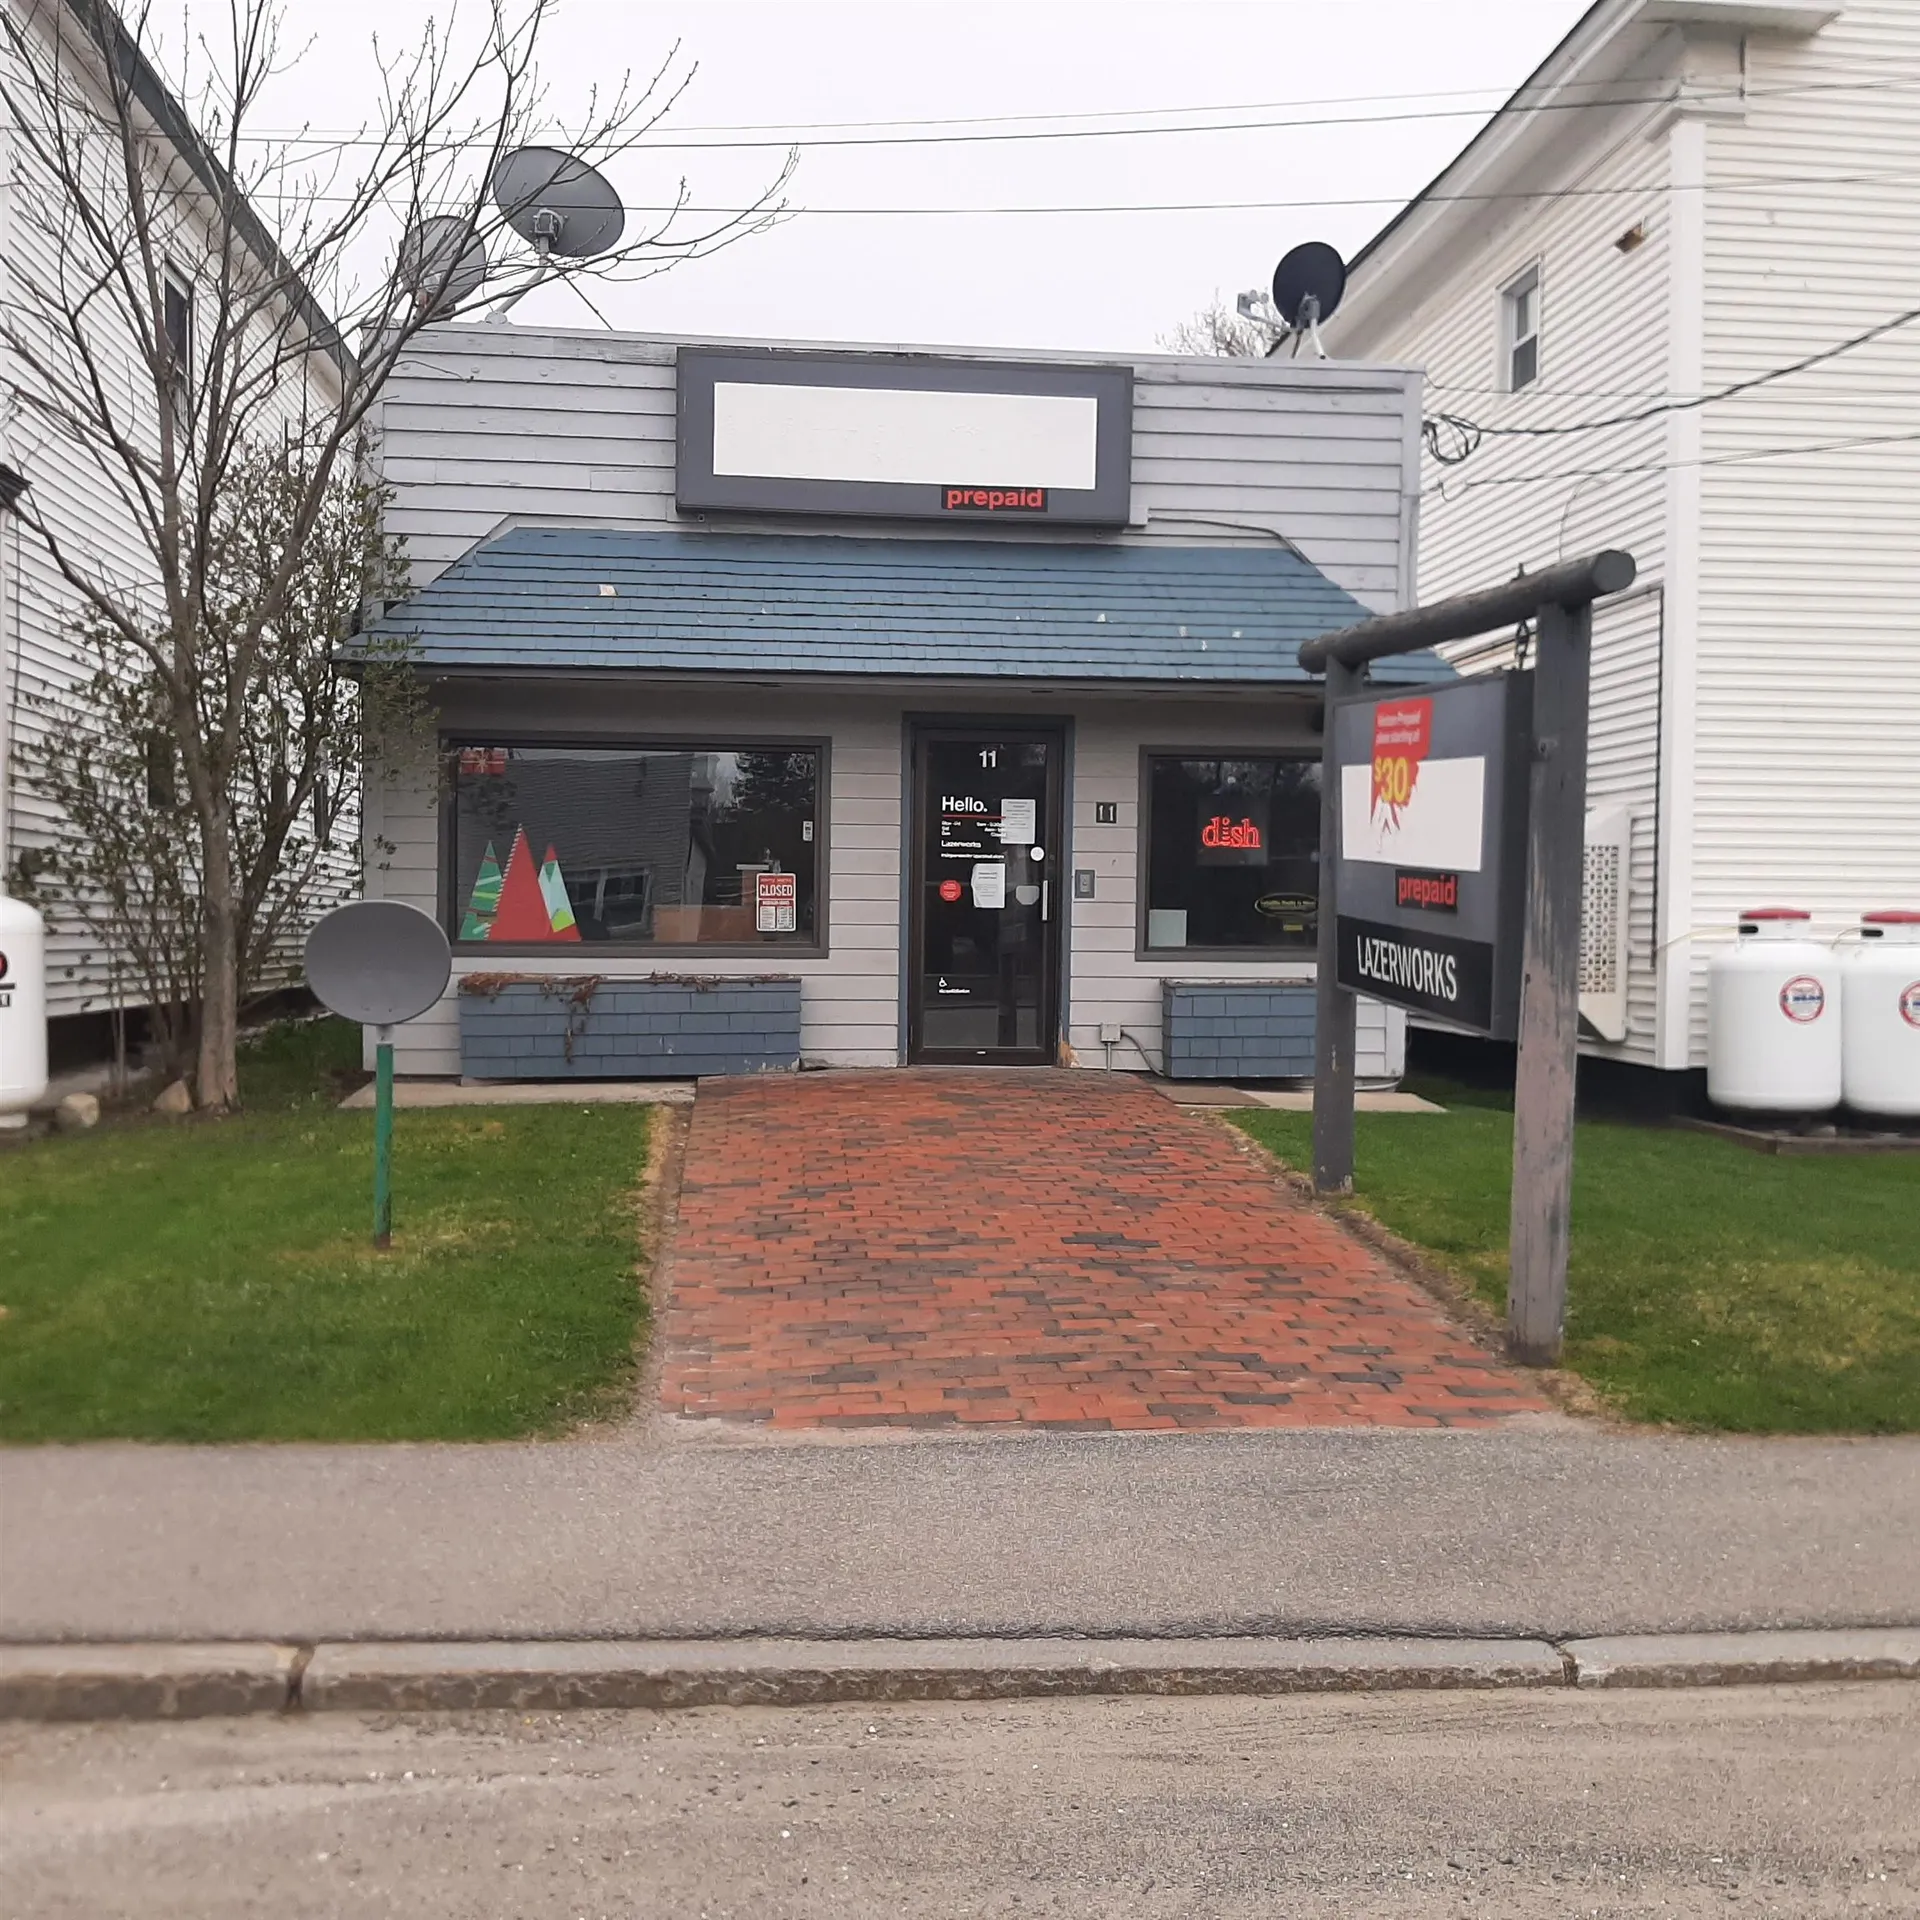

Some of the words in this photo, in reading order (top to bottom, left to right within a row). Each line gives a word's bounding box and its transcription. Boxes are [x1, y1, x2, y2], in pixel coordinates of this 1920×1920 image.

[947, 488, 1043, 511] prepaid
[979, 750, 997, 768] 11
[1374, 755, 1408, 803] $30
[942, 796, 988, 812] Hello.
[1098, 804, 1115, 822] 11
[1202, 816, 1261, 848] dish
[760, 884, 793, 896] CLOSED
[1398, 873, 1456, 908] prepaid
[1357, 934, 1457, 1001] LAZERWORKS
